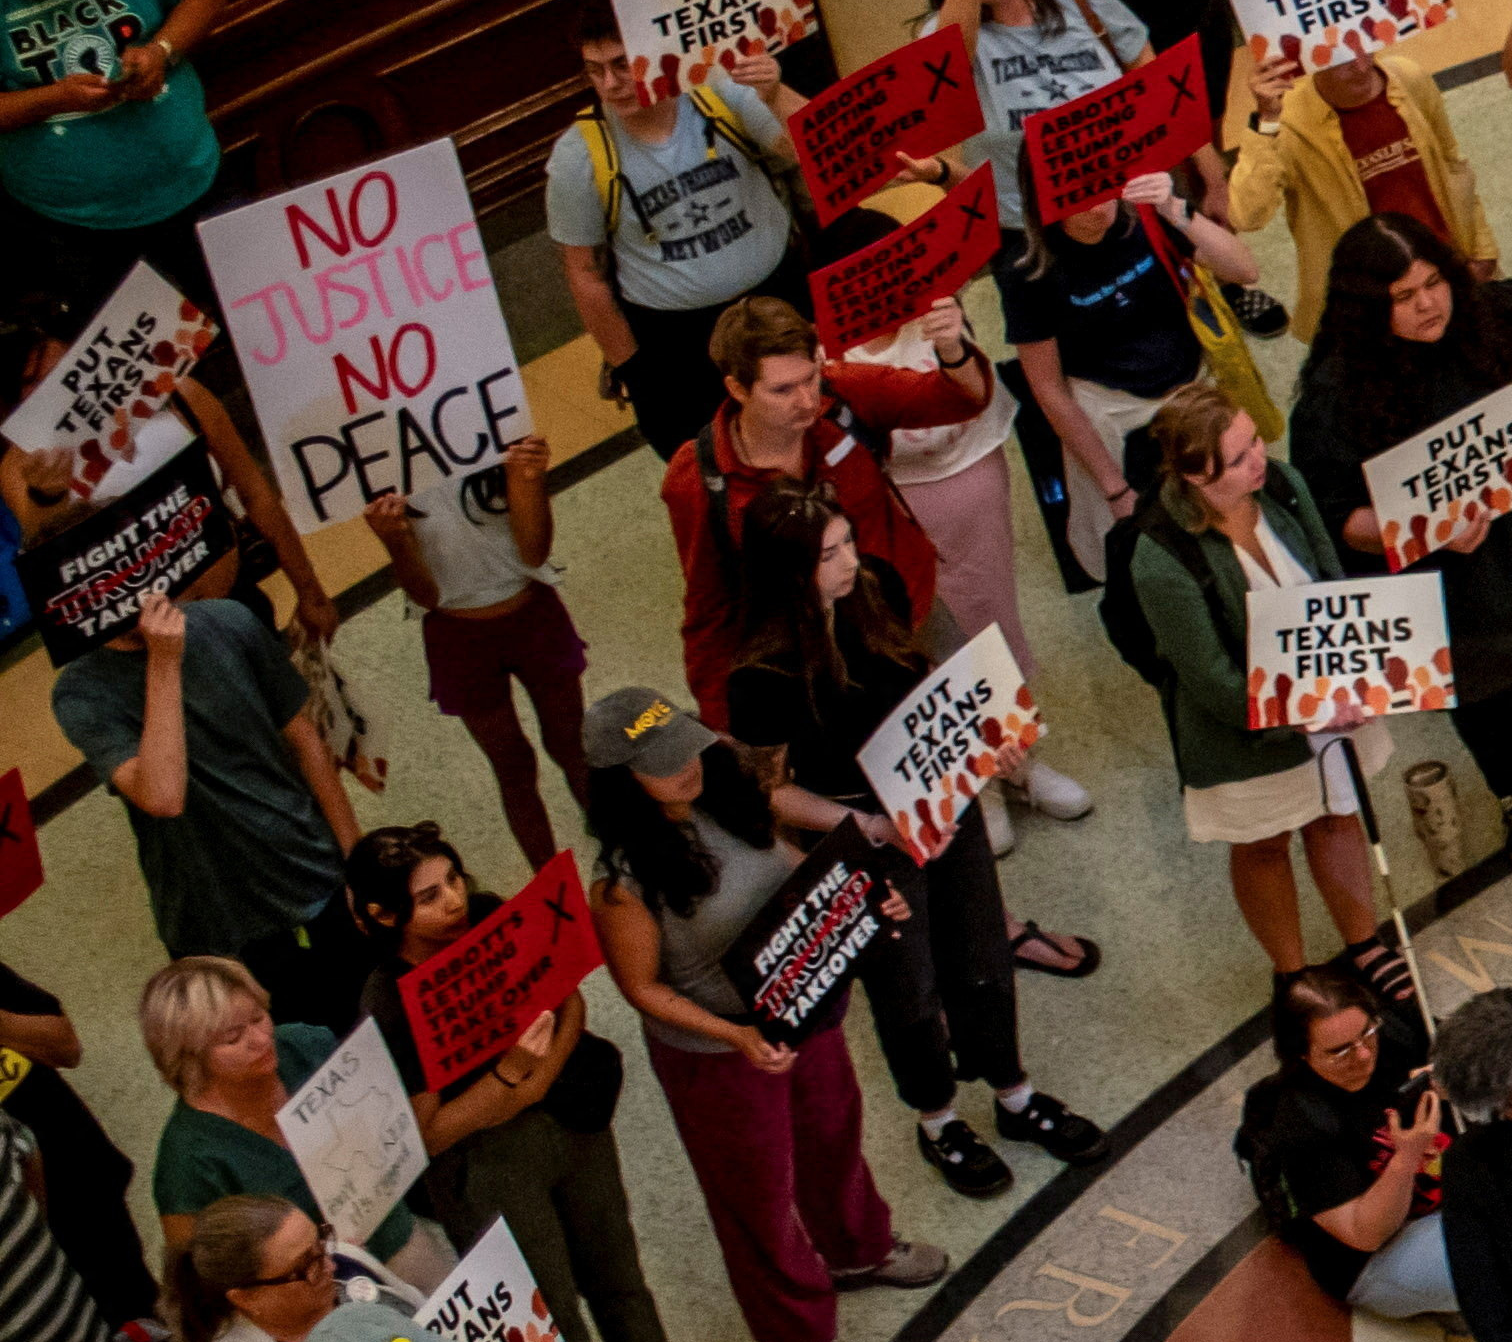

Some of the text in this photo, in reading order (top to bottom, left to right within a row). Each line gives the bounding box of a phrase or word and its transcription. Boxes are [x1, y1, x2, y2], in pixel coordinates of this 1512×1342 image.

[680, 2, 763, 53] FIRST
[284, 170, 398, 269] NO
[231, 222, 490, 366] JUSTICE
[55, 312, 156, 434] TEXANS
[62, 327, 114, 391] PUT
[89, 345, 154, 433] FIRST
[332, 323, 436, 414] NO
[291, 367, 519, 522] PEACE
[1427, 412, 1487, 461] PUT
[1428, 453, 1508, 512] FIRST
[59, 484, 191, 584] FIGHT THE
[1276, 617, 1412, 654] TEXANS
[1306, 593, 1371, 622] PUT
[1296, 648, 1391, 679] FIRST
[893, 679, 993, 785] TEXANS
[903, 678, 957, 739] PUT
[919, 717, 984, 793] FIRST
[753, 862, 851, 975] FIGHT THE
[783, 916, 880, 1028] TAKEOVER
[295, 1050, 360, 1124] TEXAS
